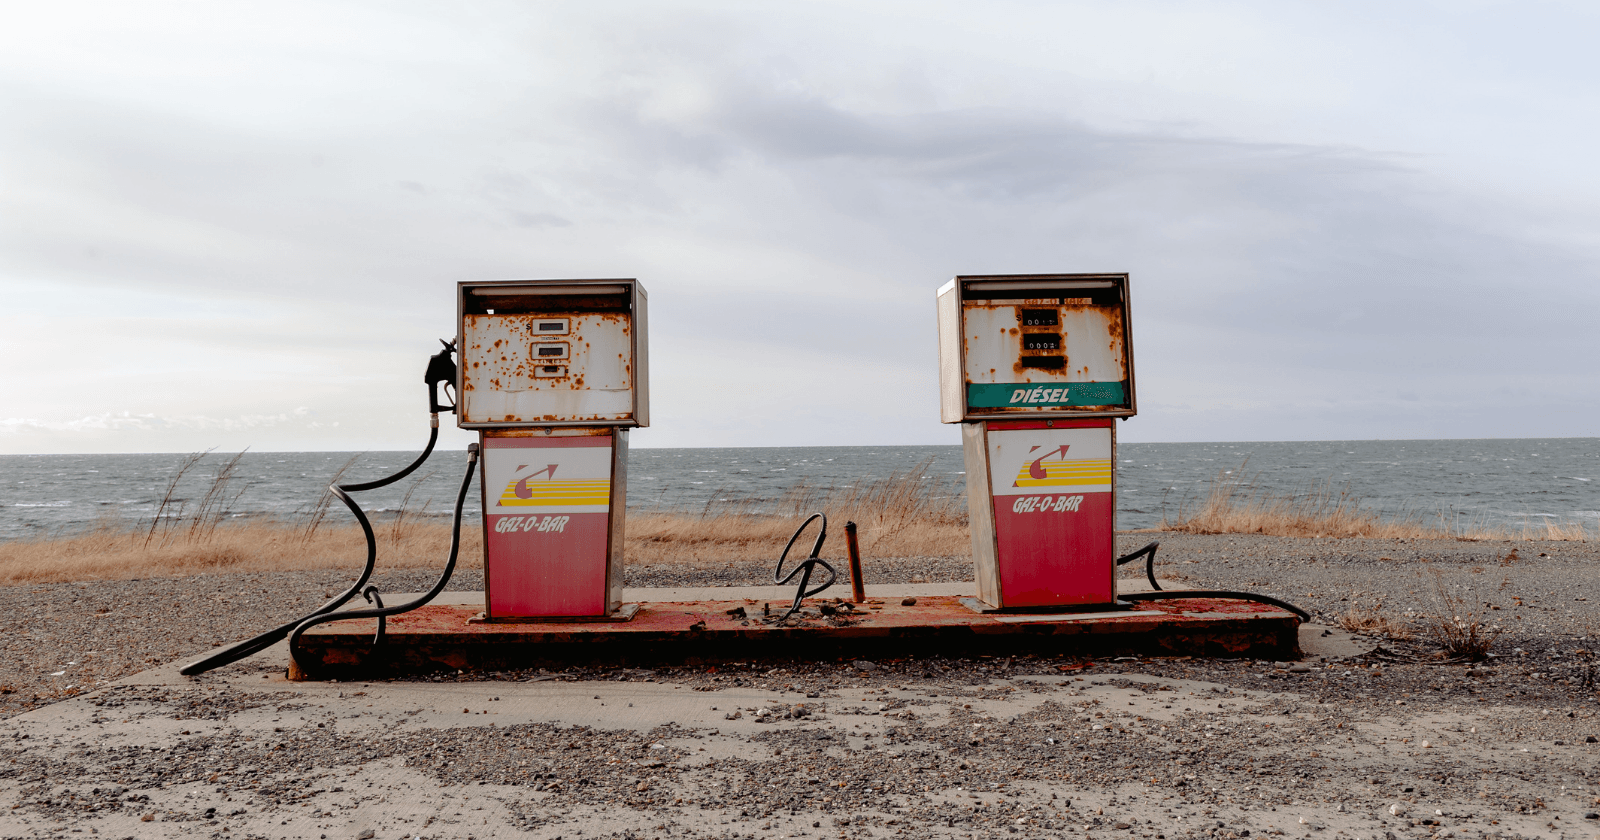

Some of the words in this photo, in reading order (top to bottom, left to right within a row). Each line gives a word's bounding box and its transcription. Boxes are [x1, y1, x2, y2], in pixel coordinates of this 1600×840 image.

[1009, 386, 1070, 404] DIÉSEL
[1013, 495, 1083, 514] GAZ-O-BAR
[495, 516, 569, 533] GAZ-O-BAR
